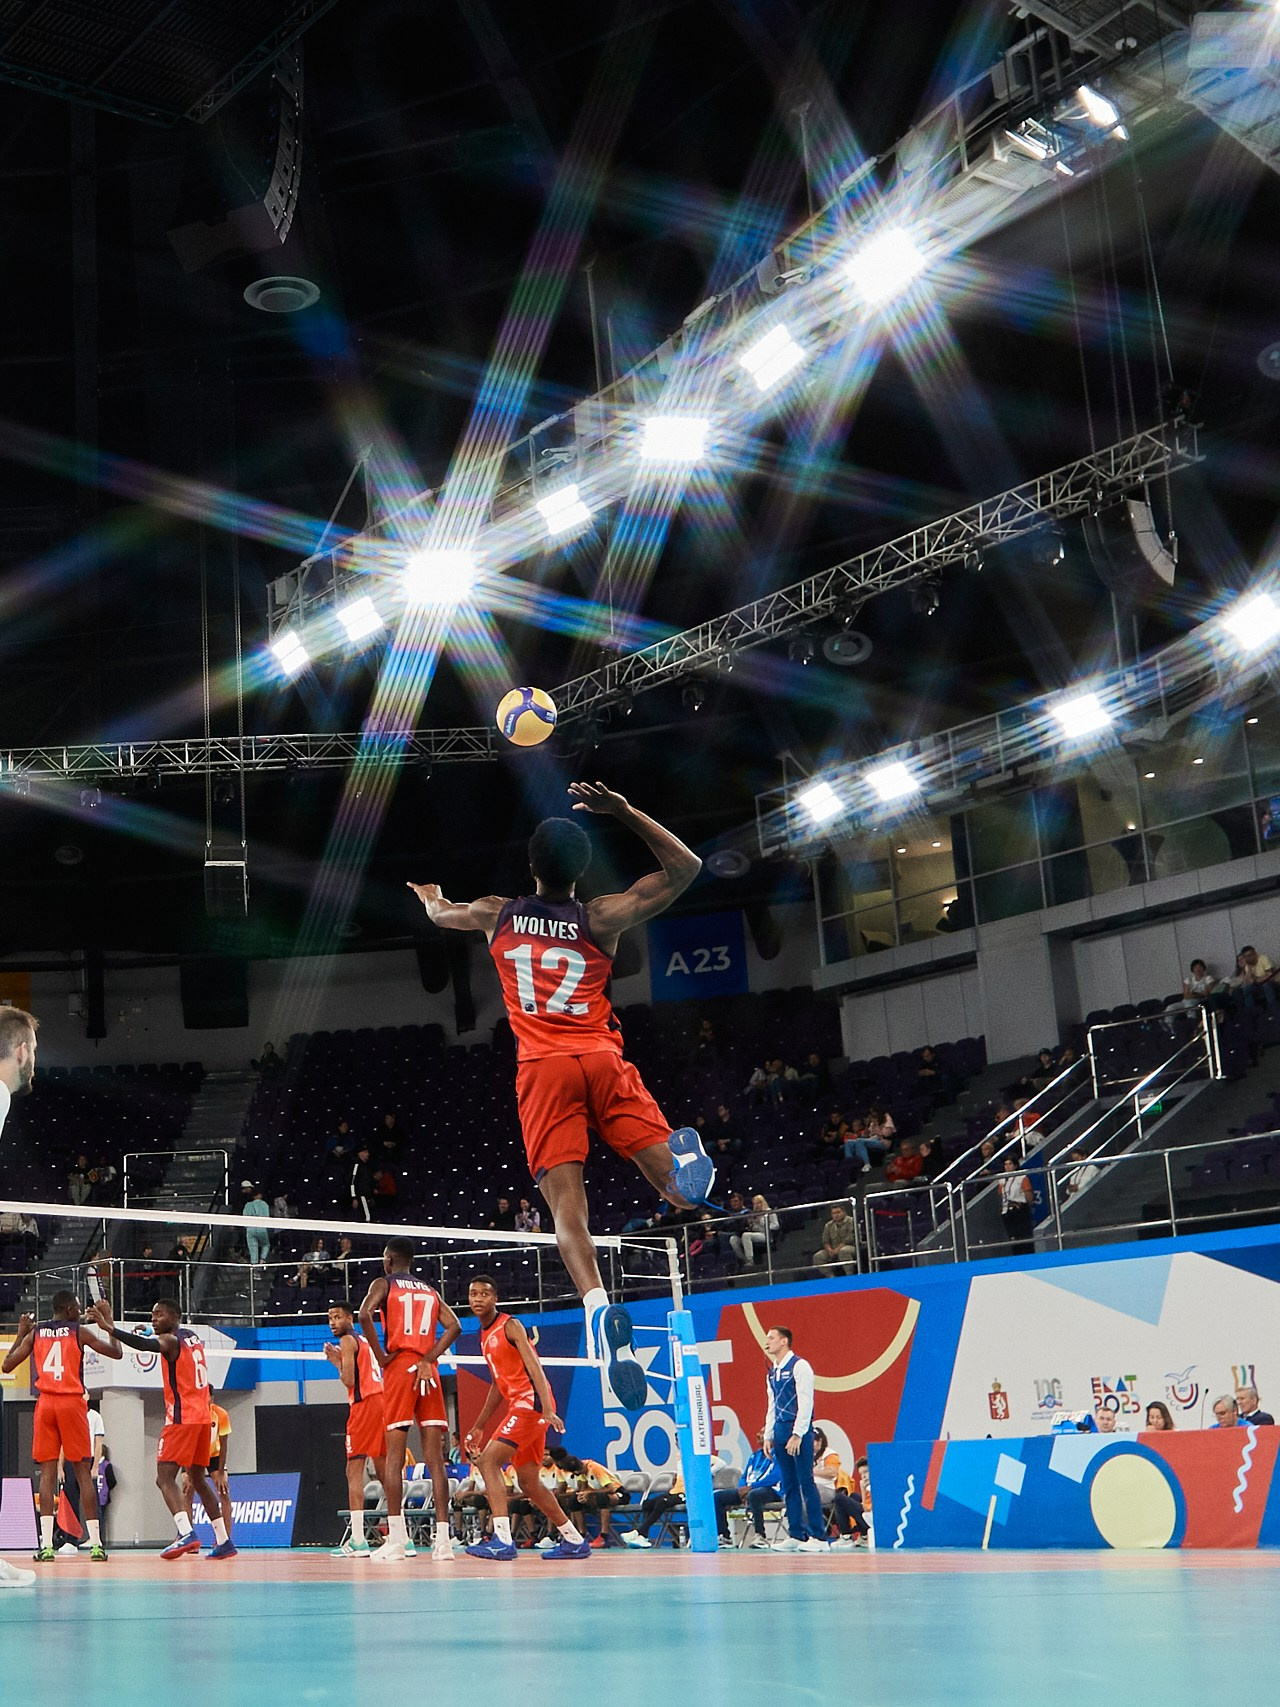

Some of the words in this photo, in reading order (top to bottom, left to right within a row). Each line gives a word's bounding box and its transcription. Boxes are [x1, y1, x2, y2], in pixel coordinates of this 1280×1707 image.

[512, 914, 579, 941] WOLVES
[503, 943, 590, 1015] 12
[39, 1327, 70, 1338] WOLVES
[398, 1292, 435, 1336] 17
[42, 1341, 65, 1381] 4
[1091, 1374, 1137, 1393] EKAT
[695, 1384, 707, 1448] EKATERINBURG
[604, 1405, 744, 1474] 203
[191, 1500, 292, 1525] ЕКАРИНБУРГ
